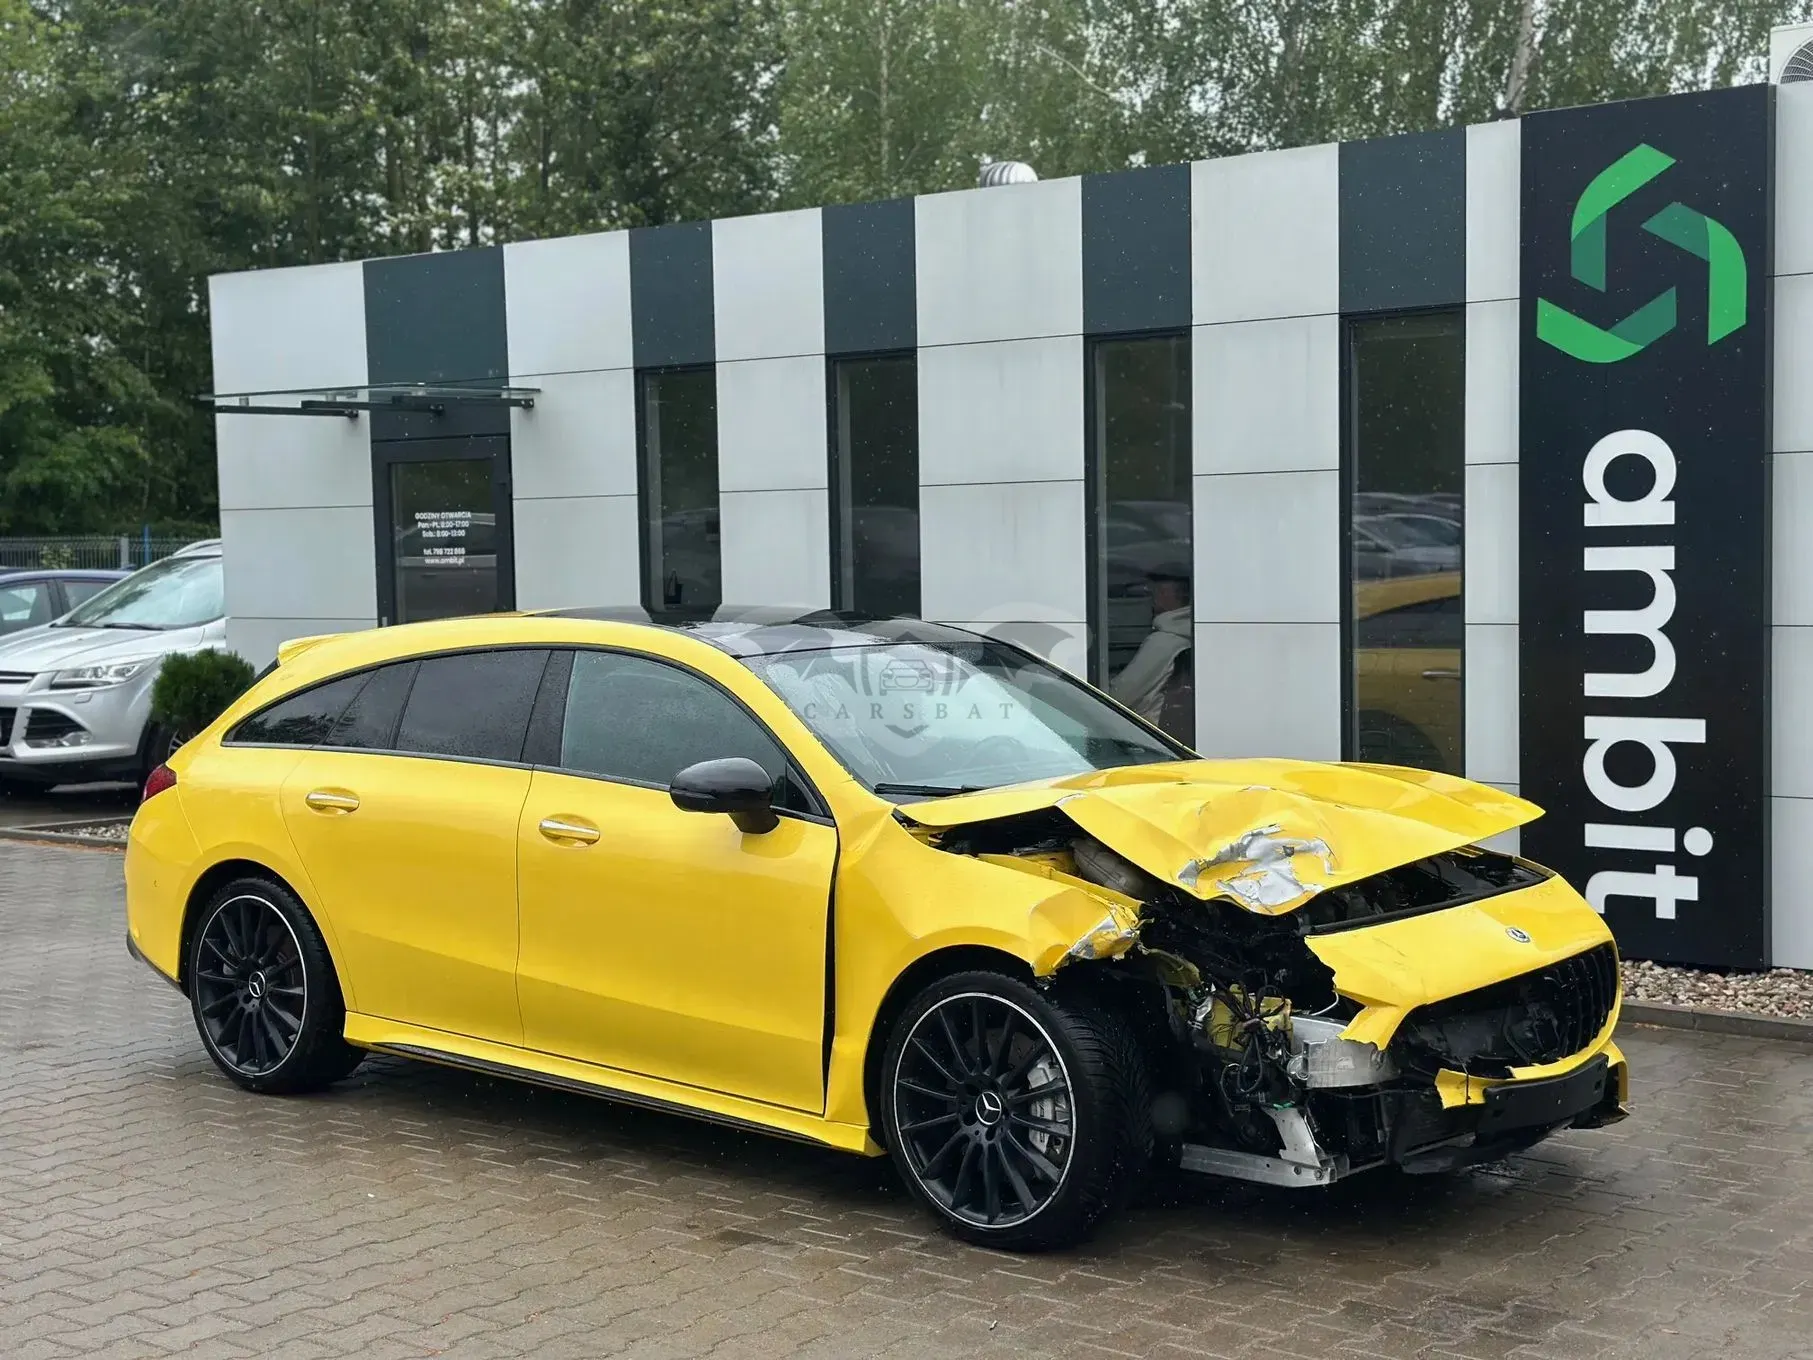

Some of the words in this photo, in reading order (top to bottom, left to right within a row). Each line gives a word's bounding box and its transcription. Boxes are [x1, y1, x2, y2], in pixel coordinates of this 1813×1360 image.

[415, 512, 440, 520] GODZINY
[441, 511, 471, 519] OTWARCIA
[1583, 429, 1713, 919] ambit
